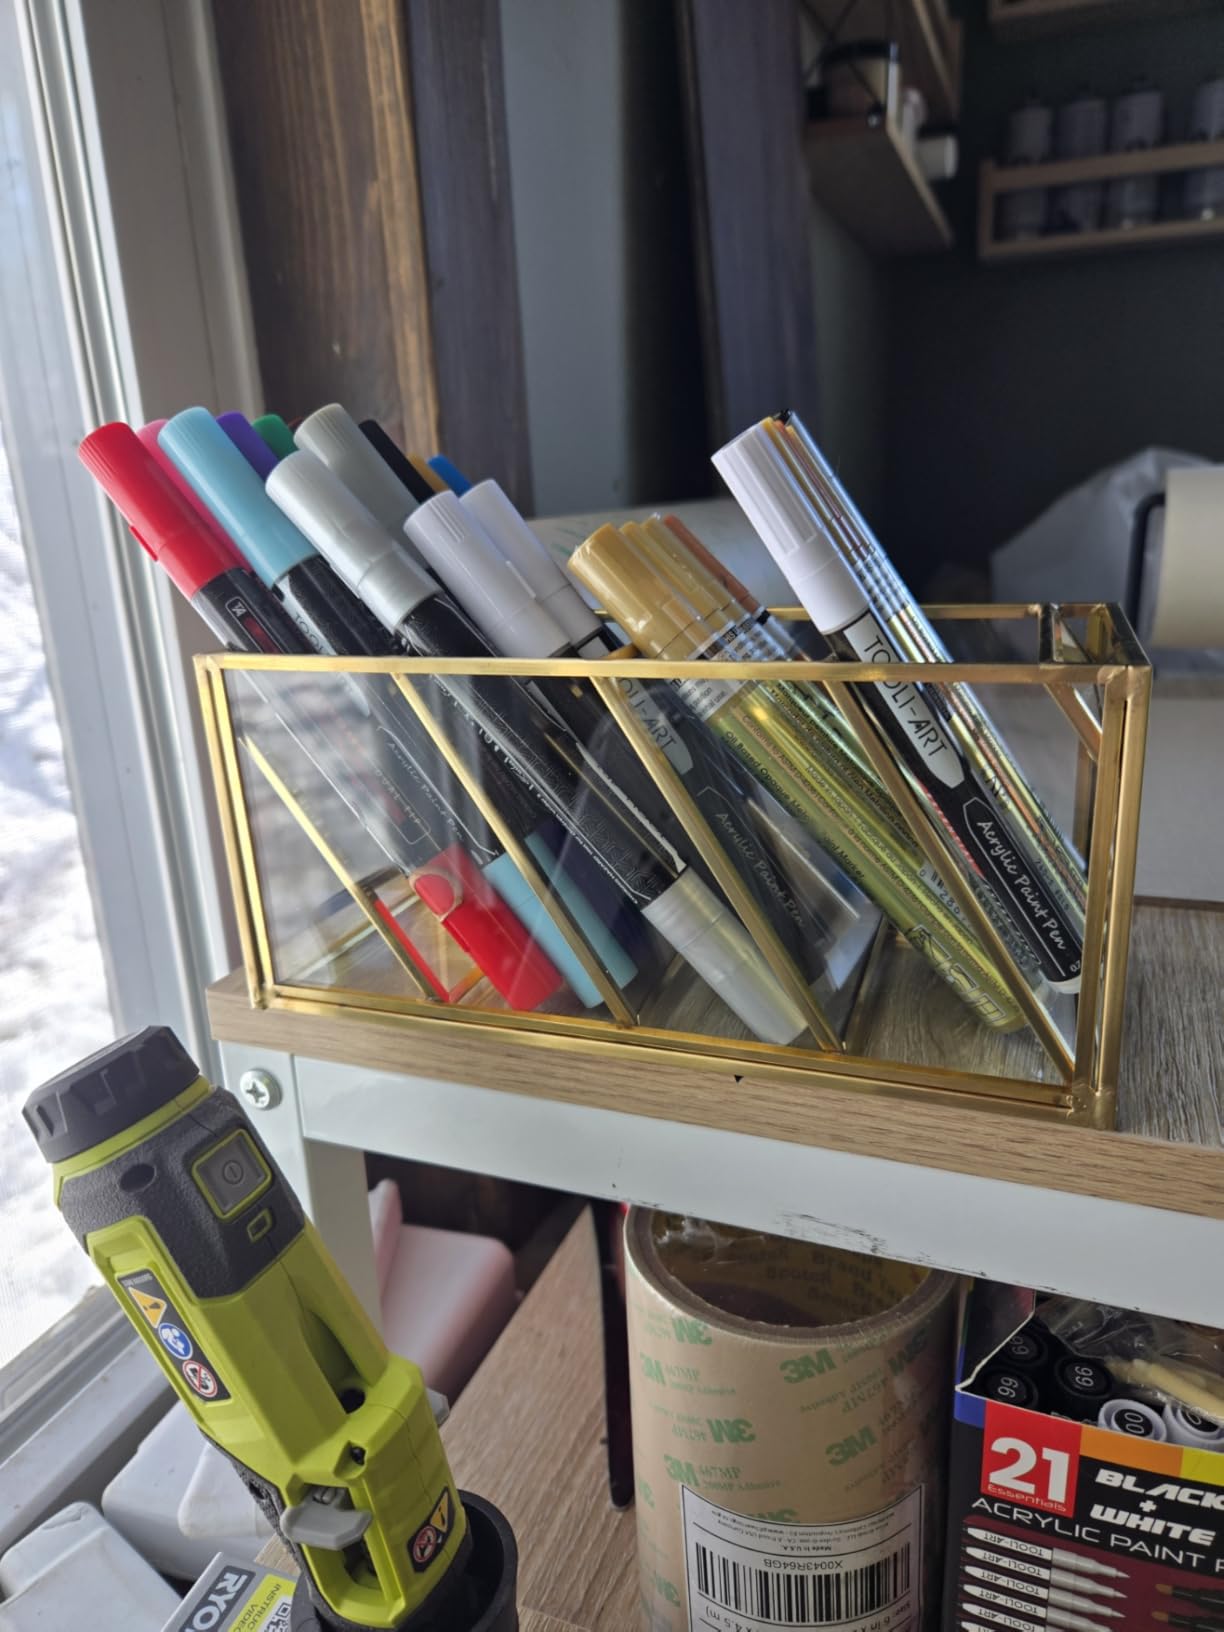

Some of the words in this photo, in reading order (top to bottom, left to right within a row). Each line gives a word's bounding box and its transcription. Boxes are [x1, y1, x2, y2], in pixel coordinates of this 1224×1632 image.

[611, 675, 680, 752] OLI-ART
[723, 729, 739, 746] Oil
[734, 741, 762, 770] Based
[756, 766, 792, 803] Opaque
[836, 849, 866, 881] Marker
[712, 808, 759, 862] Acrylic
[752, 858, 791, 902] Paint
[781, 897, 810, 928] Pen
[972, 815, 1023, 881] Acrylic
[1011, 875, 1047, 920] Paint
[1040, 917, 1070, 954] Pen
[779, 1348, 837, 1385] 3M
[708, 1418, 756, 1444] 3M
[825, 1425, 878, 1466] 3M
[664, 1454, 699, 1488] 3M
[989, 1437, 1070, 1504] 21
[986, 1483, 1068, 1513] Essentials
[1095, 1468, 1224, 1511] BLACK
[971, 1497, 1101, 1543] ACRYLIC
[1110, 1533, 1206, 1568] PAINT
[1090, 1504, 1216, 1547] WHITE
[983, 1532, 1044, 1557] TOOLI-ART
[764, 1558, 843, 1570] X0043R64GB
[982, 1552, 1042, 1577] TOOLI-ART
[981, 1571, 1040, 1596] TOOLI-ART
[184, 1572, 248, 1632] RYO
[705, 1606, 721, 1621] m)
[979, 1589, 1038, 1614] TOOLI-ART
[724, 1617, 743, 1631] 4.5
[870, 1621, 882, 1631] in
